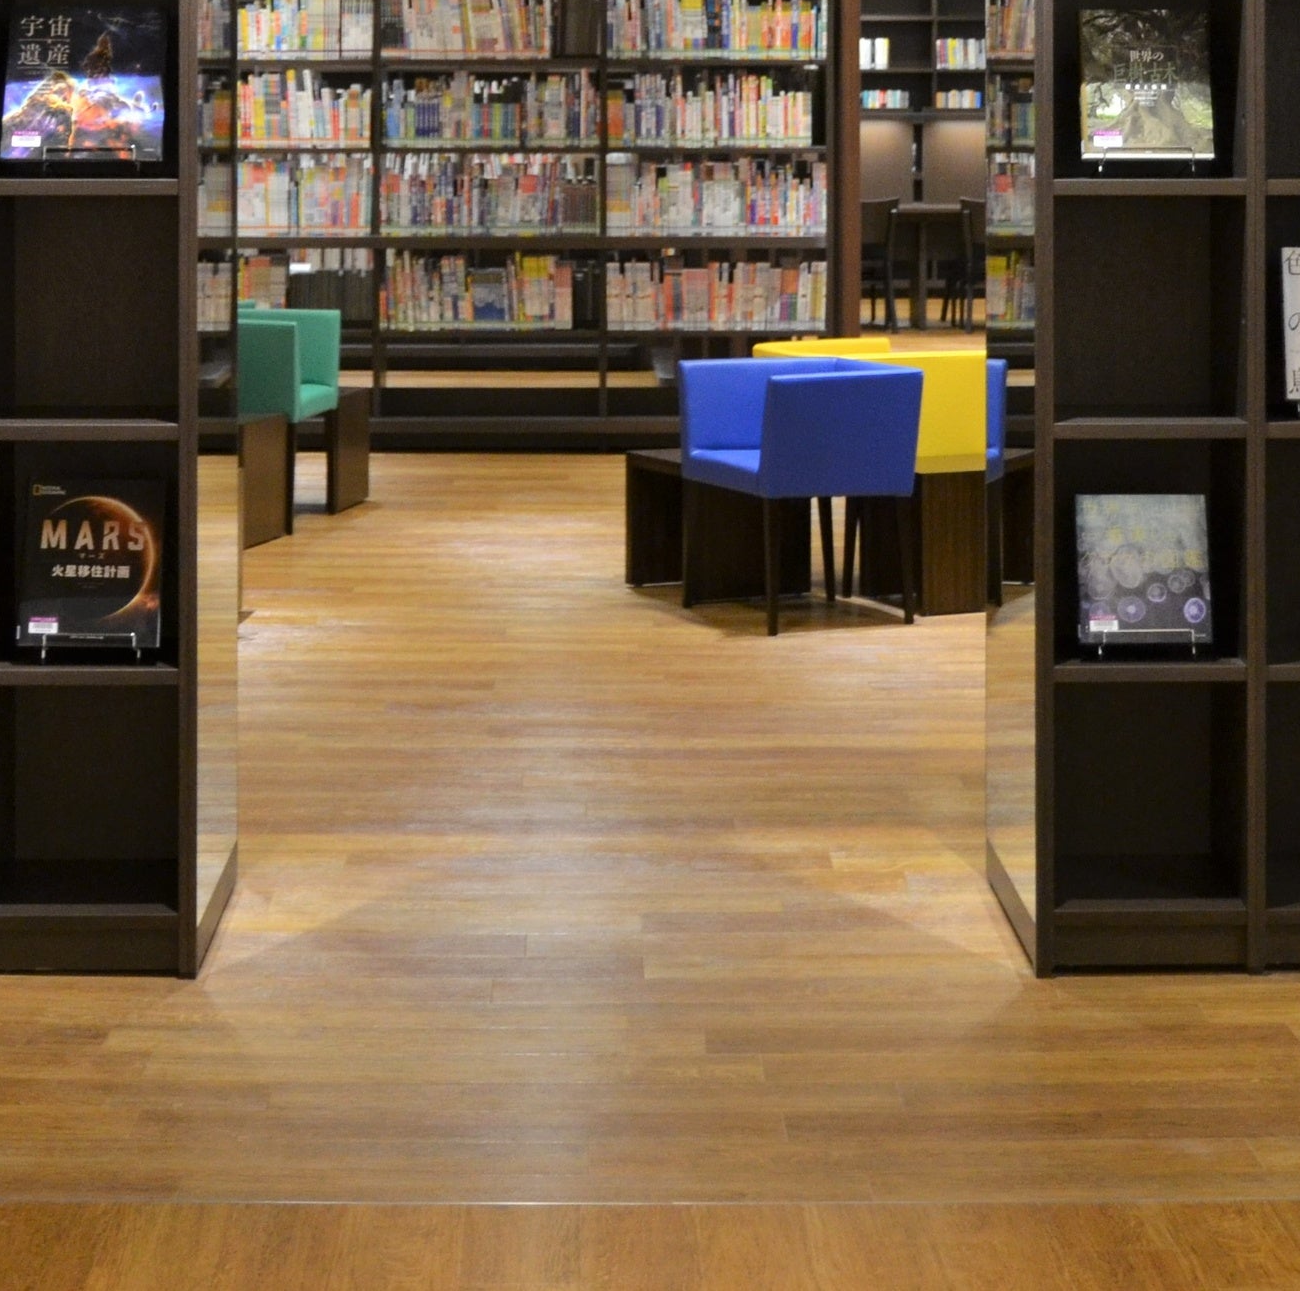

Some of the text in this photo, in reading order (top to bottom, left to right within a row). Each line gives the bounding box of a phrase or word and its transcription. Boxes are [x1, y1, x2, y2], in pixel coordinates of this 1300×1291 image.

[20, 15, 73, 37] 宇宙
[17, 44, 71, 65] 遺産
[1129, 50, 1165, 63] 世界の
[40, 519, 146, 551] MARS
[51, 565, 131, 579] 火星移住計画
